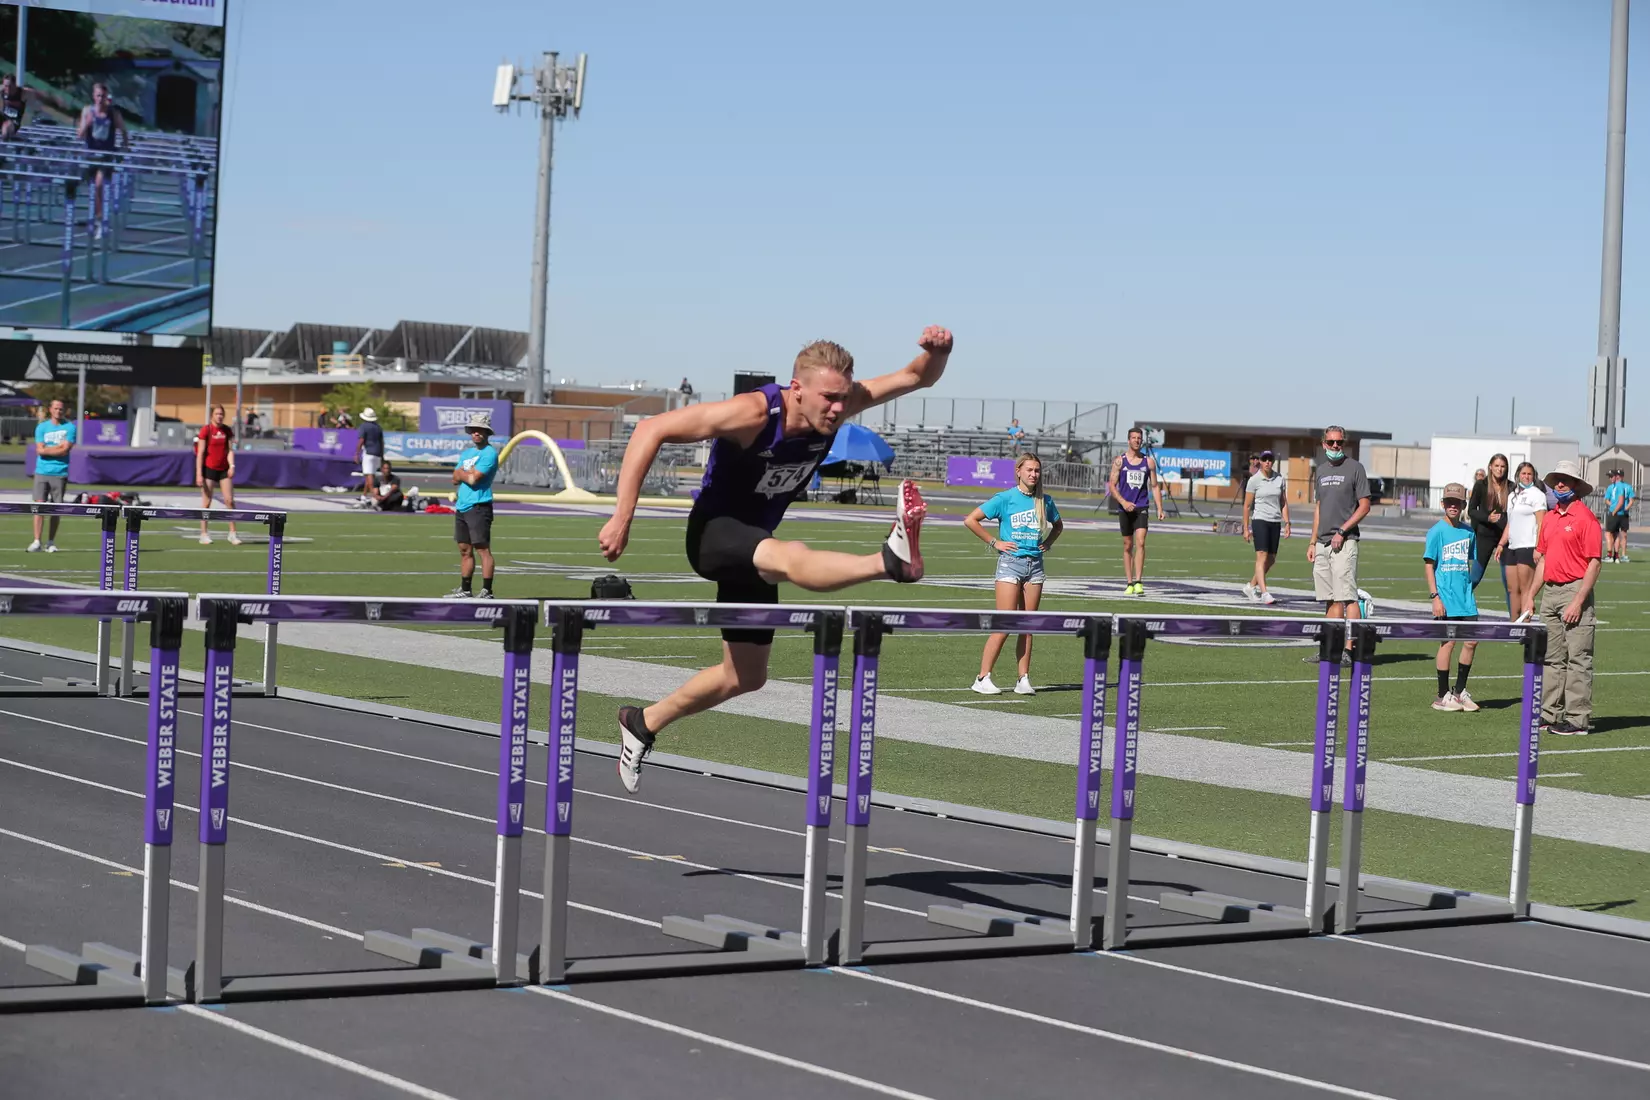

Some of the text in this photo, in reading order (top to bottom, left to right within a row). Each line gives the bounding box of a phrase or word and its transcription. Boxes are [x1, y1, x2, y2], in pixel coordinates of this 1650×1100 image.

[406, 438, 468, 450] CHAMPIO
[1160, 457, 1226, 470] CHAMPIONSHIP
[768, 466, 806, 488] 574
[1012, 511, 1039, 523] BIGSK
[106, 538, 114, 564] STATE
[130, 540, 138, 565] STATE
[117, 600, 148, 612] GILL
[240, 602, 270, 615] GILL
[475, 608, 503, 618] GILL
[584, 609, 610, 620] GILL
[790, 612, 814, 623] GILL
[1063, 619, 1085, 628] GILL
[1302, 624, 1322, 633] GILL
[1509, 628, 1527, 637] GILL
[157, 665, 175, 788] WEBER STATE
[212, 666, 229, 788] WEBER STATE
[510, 668, 528, 784] WEBER STATE
[559, 668, 575, 783] WEBER STATE
[820, 670, 836, 777] WEBER STATE
[859, 670, 875, 777] WEBER STATE
[1090, 673, 1104, 773] WEBER STATE
[1125, 673, 1140, 773] WEBER STATE
[1324, 674, 1339, 768] WEBER STATE
[1357, 674, 1370, 768] WEBER STATE
[1529, 675, 1542, 763] WEBER STATE
